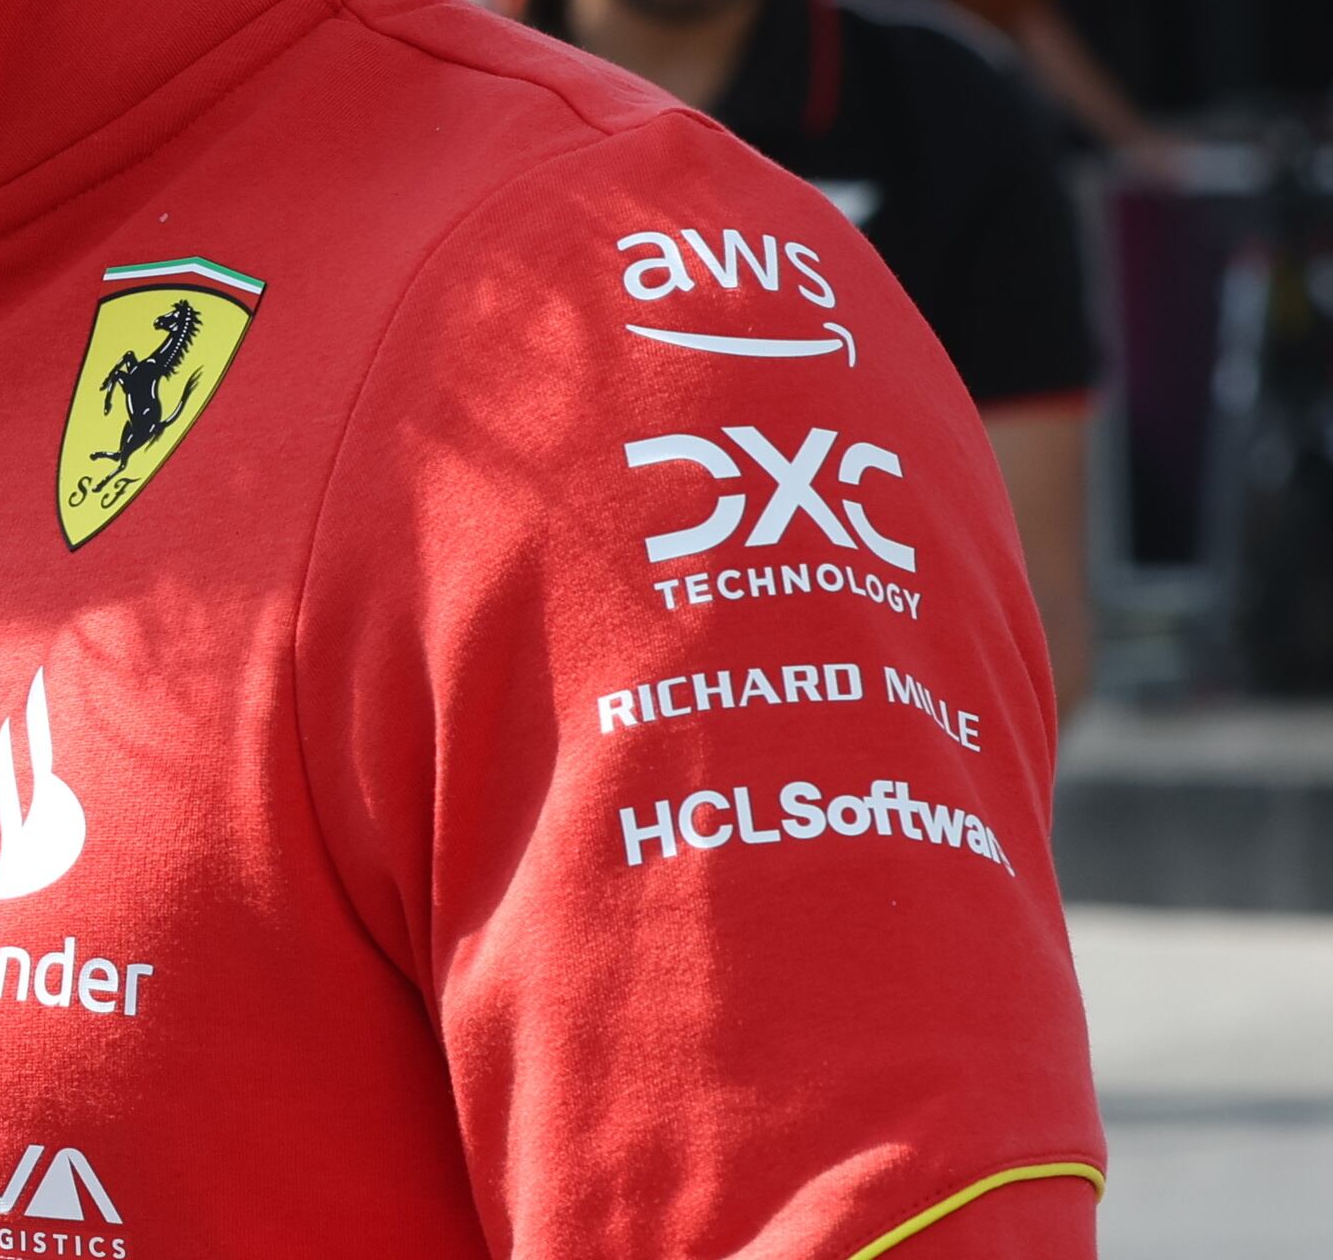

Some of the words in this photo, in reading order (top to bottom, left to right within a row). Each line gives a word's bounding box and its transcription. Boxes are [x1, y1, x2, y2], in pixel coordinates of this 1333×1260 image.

[617, 229, 835, 309] aws
[624, 426, 917, 573] DXC
[654, 563, 921, 620] TECHNOLOGY
[597, 663, 863, 735] RICHARD
[884, 666, 981, 753] MILLE
